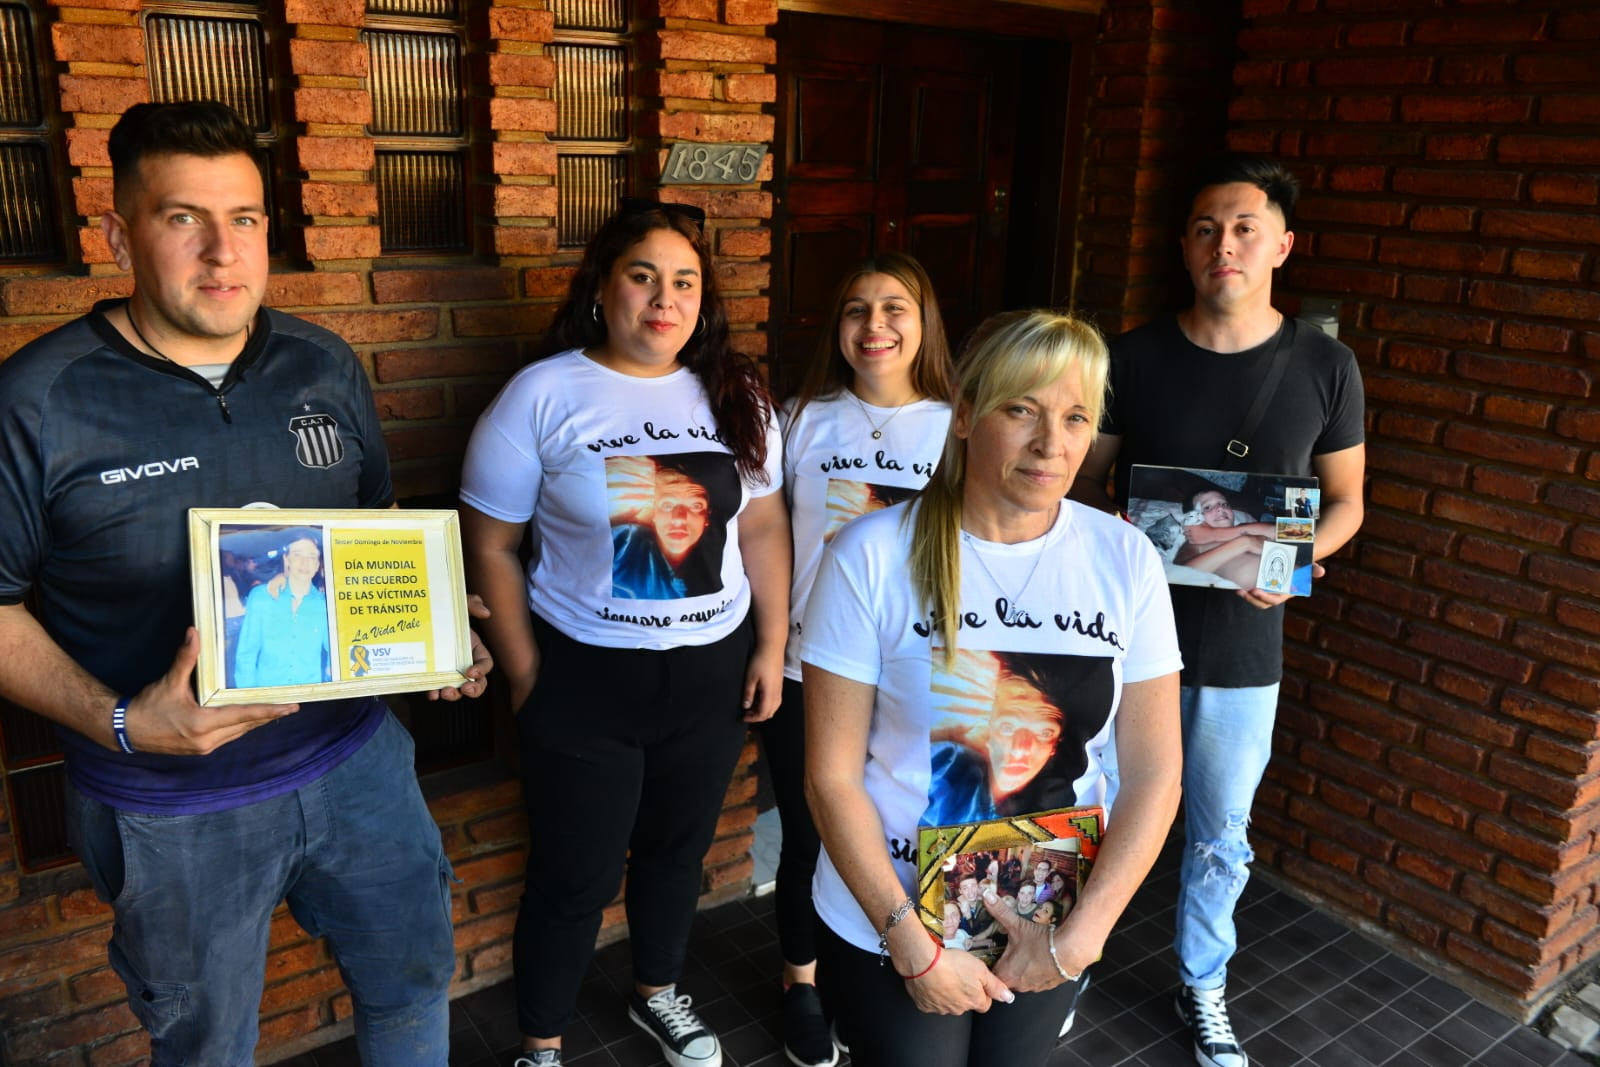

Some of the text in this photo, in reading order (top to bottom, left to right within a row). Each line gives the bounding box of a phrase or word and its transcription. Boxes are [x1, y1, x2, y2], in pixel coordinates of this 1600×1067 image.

[671, 148, 760, 181] 1845
[587, 421, 729, 453] vive la vid
[100, 456, 199, 485] GIVOVA
[820, 450, 934, 478] vive la vi
[354, 538, 381, 546] Domingo
[344, 558, 416, 570] DÍA MUNDIAL
[345, 575, 418, 585] EN RECUERDO
[338, 588, 426, 601] DE LAS VÍCTIMAS
[350, 603, 418, 615] DE TRÁNSITO
[351, 618, 421, 643] La Vida Vale
[913, 597, 1125, 651] vie la vida
[372, 647, 391, 657] VSV
